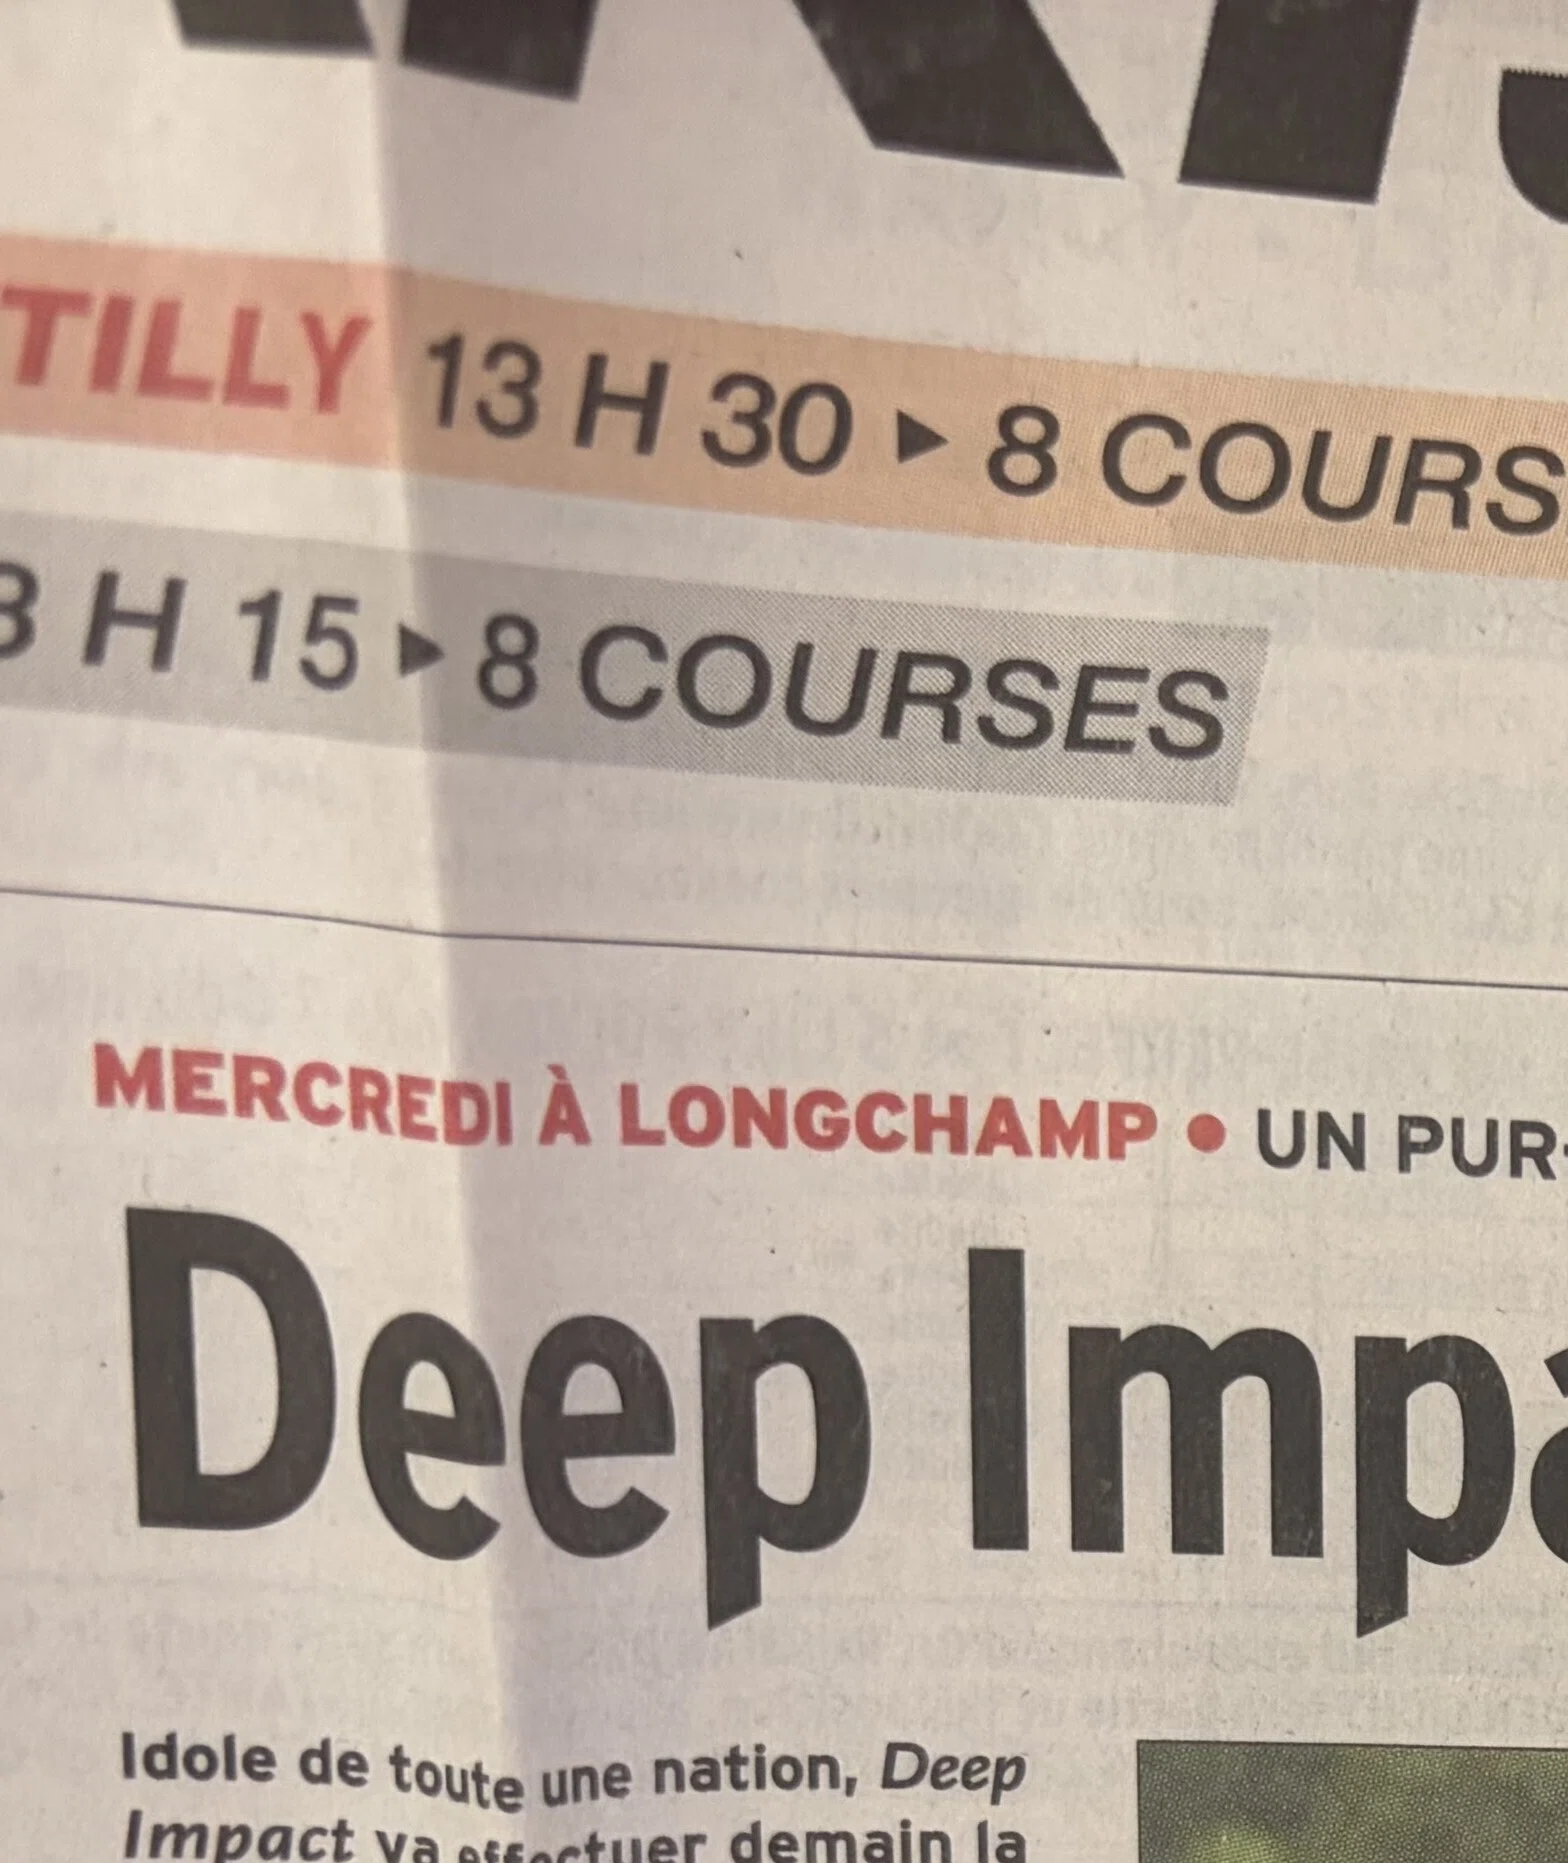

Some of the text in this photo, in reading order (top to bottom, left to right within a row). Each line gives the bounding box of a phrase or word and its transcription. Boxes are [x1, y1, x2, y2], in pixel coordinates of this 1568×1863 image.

[426, 331, 542, 439] 13
[573, 352, 670, 456] H
[700, 370, 853, 476] 30
[985, 403, 1060, 497] 8
[81, 569, 186, 672] H
[239, 588, 358, 691] 15
[475, 612, 539, 711] 8
[578, 623, 1230, 762] COURSES
[93, 1042, 513, 1147] MERCREDI
[538, 1064, 591, 1146] À
[620, 1082, 1158, 1161] LONGCHAMP
[1256, 1107, 1366, 1172] UN
[124, 1205, 872, 1632] Deep
[121, 1731, 1026, 1814] Idole de toute une nation, Deep
